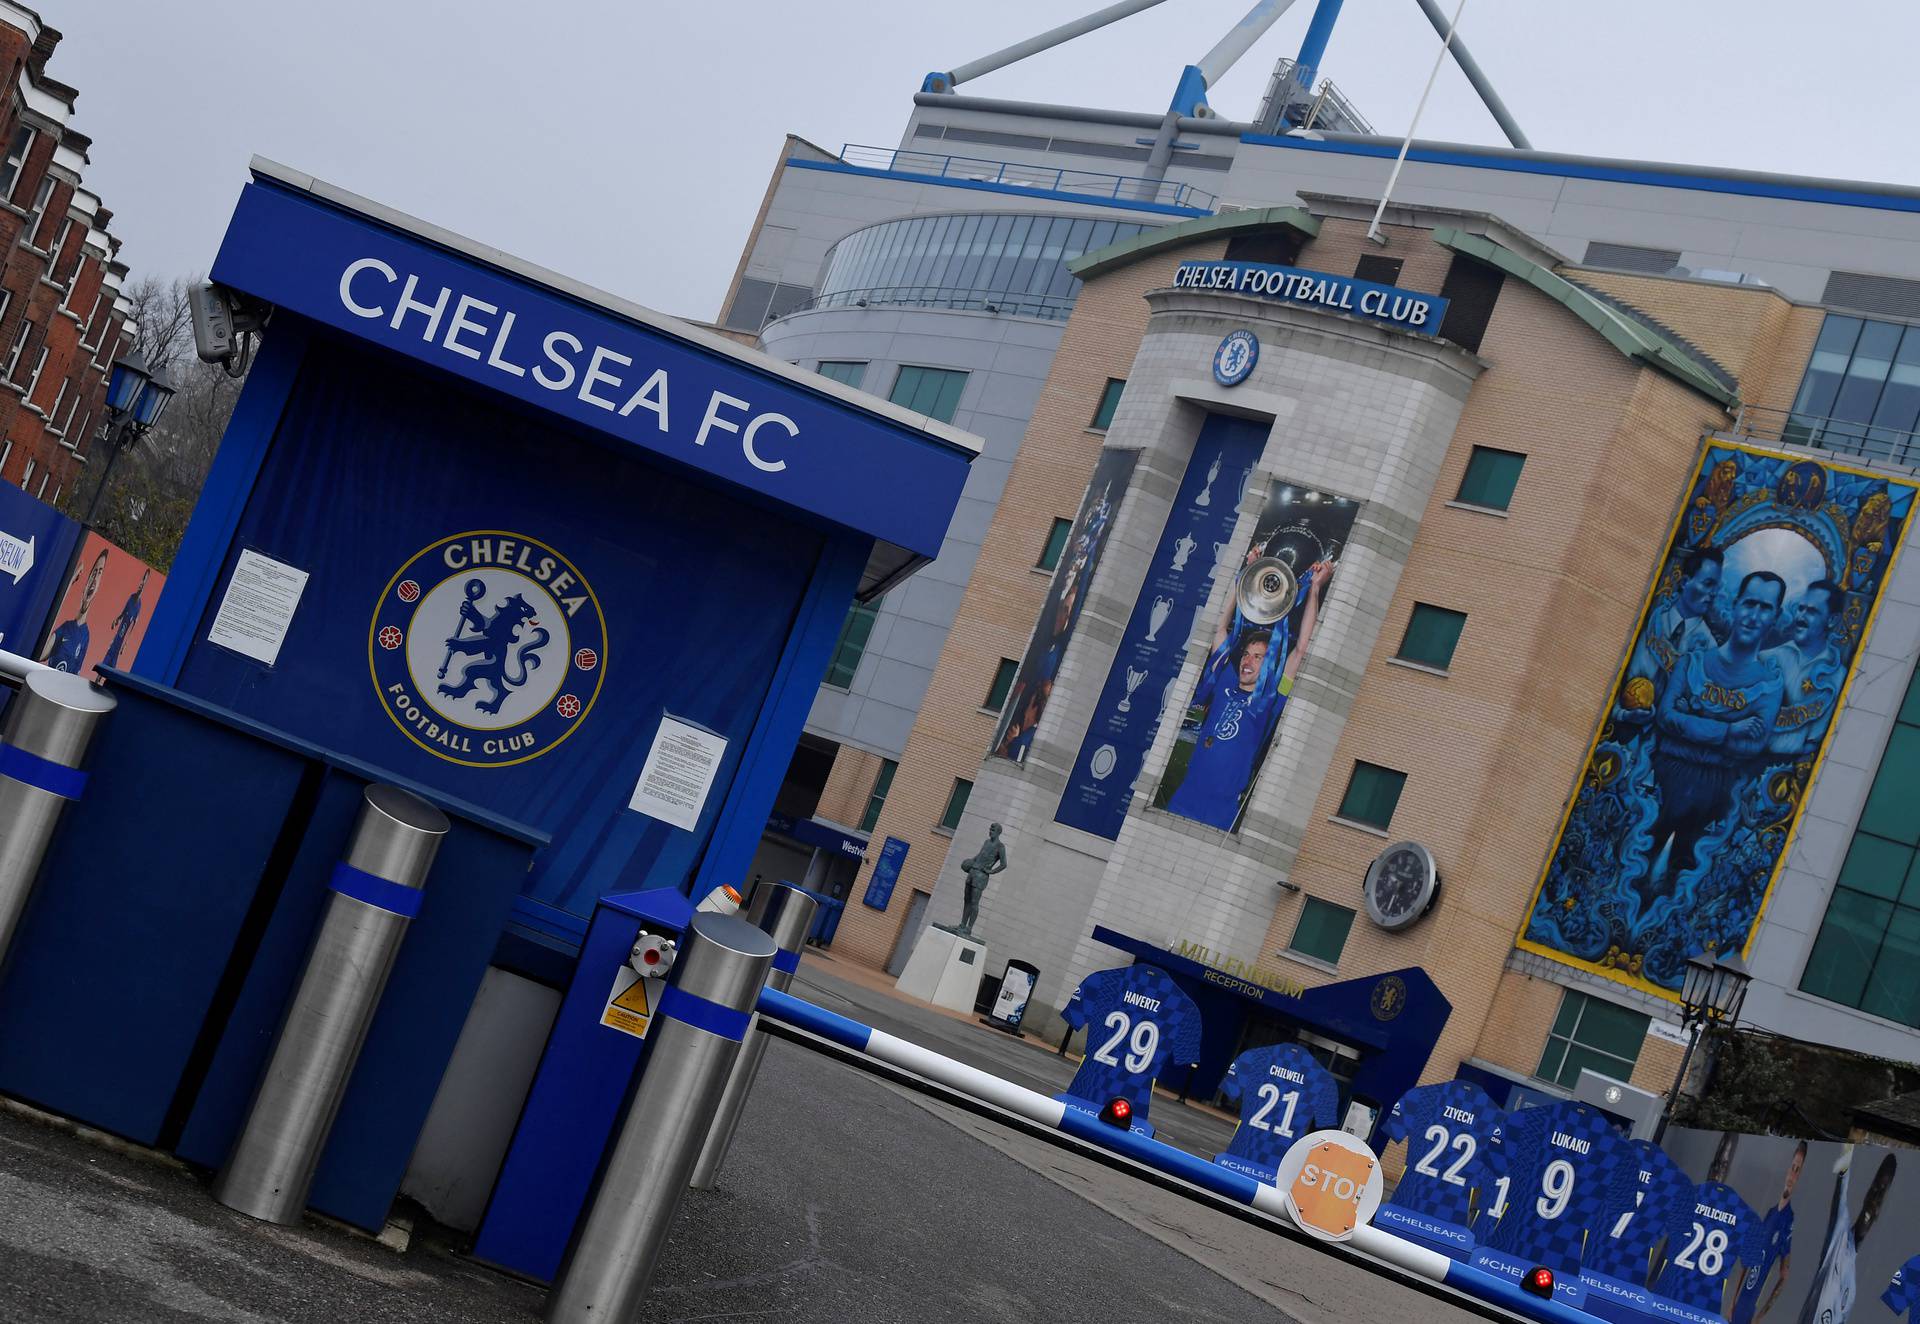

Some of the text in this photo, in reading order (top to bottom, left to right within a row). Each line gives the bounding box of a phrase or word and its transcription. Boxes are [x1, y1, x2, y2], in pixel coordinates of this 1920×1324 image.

[1173, 265, 1429, 325] CHELSEA FOOTBALL CLUB
[339, 258, 800, 472] CHELSEA FC
[443, 539, 589, 618] CHELSEA
[388, 683, 536, 755] FOOTBALL CLUB
[1701, 682, 1746, 710] JONES
[1178, 939, 1306, 1000] MILLENNIUM
[1203, 969, 1265, 1000] RECEPTION
[616, 1011, 639, 1023] CAUTION
[1123, 990, 1161, 1013] HAVERTZ
[1093, 1011, 1160, 1074] 29
[1269, 1064, 1305, 1085] CHILWELL
[1248, 1083, 1300, 1139] 21
[1443, 1105, 1475, 1125] ZIYECH
[1414, 1124, 1477, 1187] 22
[1550, 1131, 1591, 1155] LUKAKU
[1536, 1159, 1576, 1220] 9
[1383, 1210, 1467, 1243] #CHELSEAFC
[1674, 1222, 1728, 1276] 28
[1579, 1274, 1647, 1304] HELSEAFC
